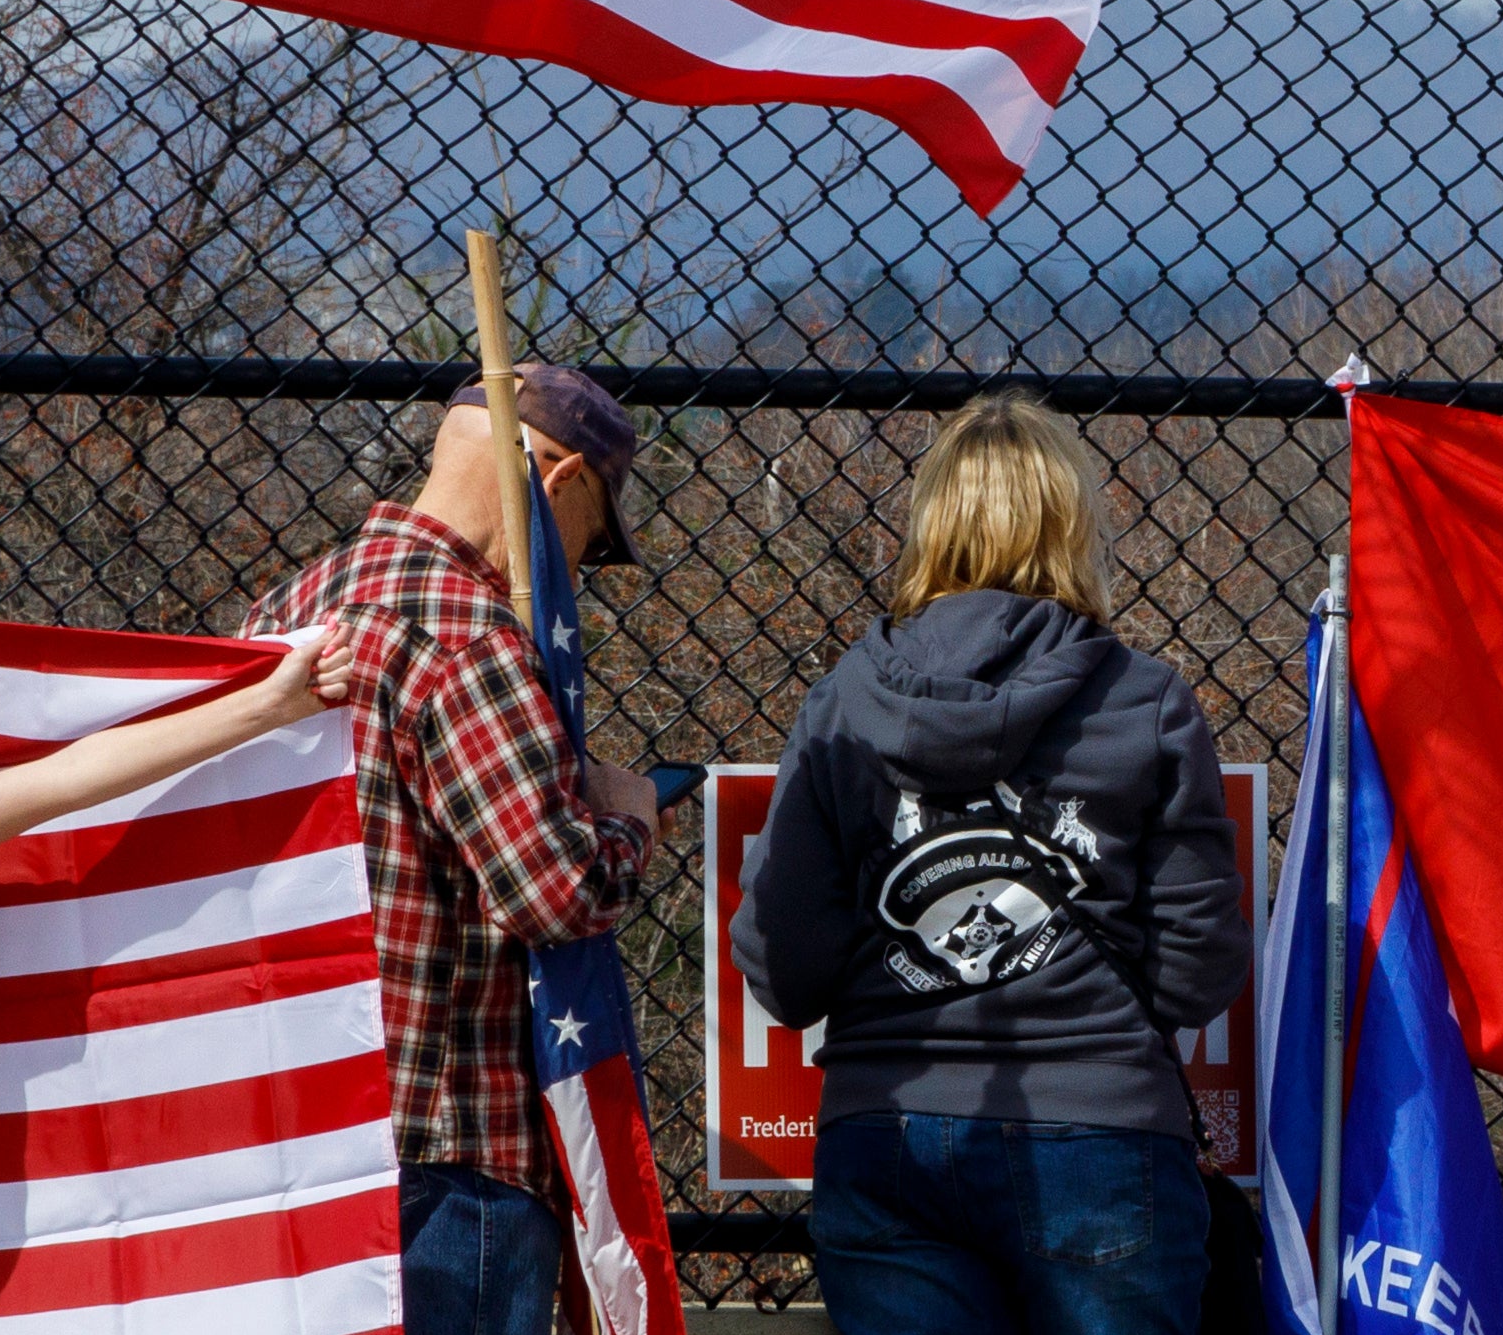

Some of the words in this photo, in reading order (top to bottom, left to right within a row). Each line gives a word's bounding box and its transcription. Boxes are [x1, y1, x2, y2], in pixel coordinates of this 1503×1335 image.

[900, 855, 976, 904] COVERING
[978, 852, 1010, 869] ALL
[1020, 925, 1058, 972] AMIGOS
